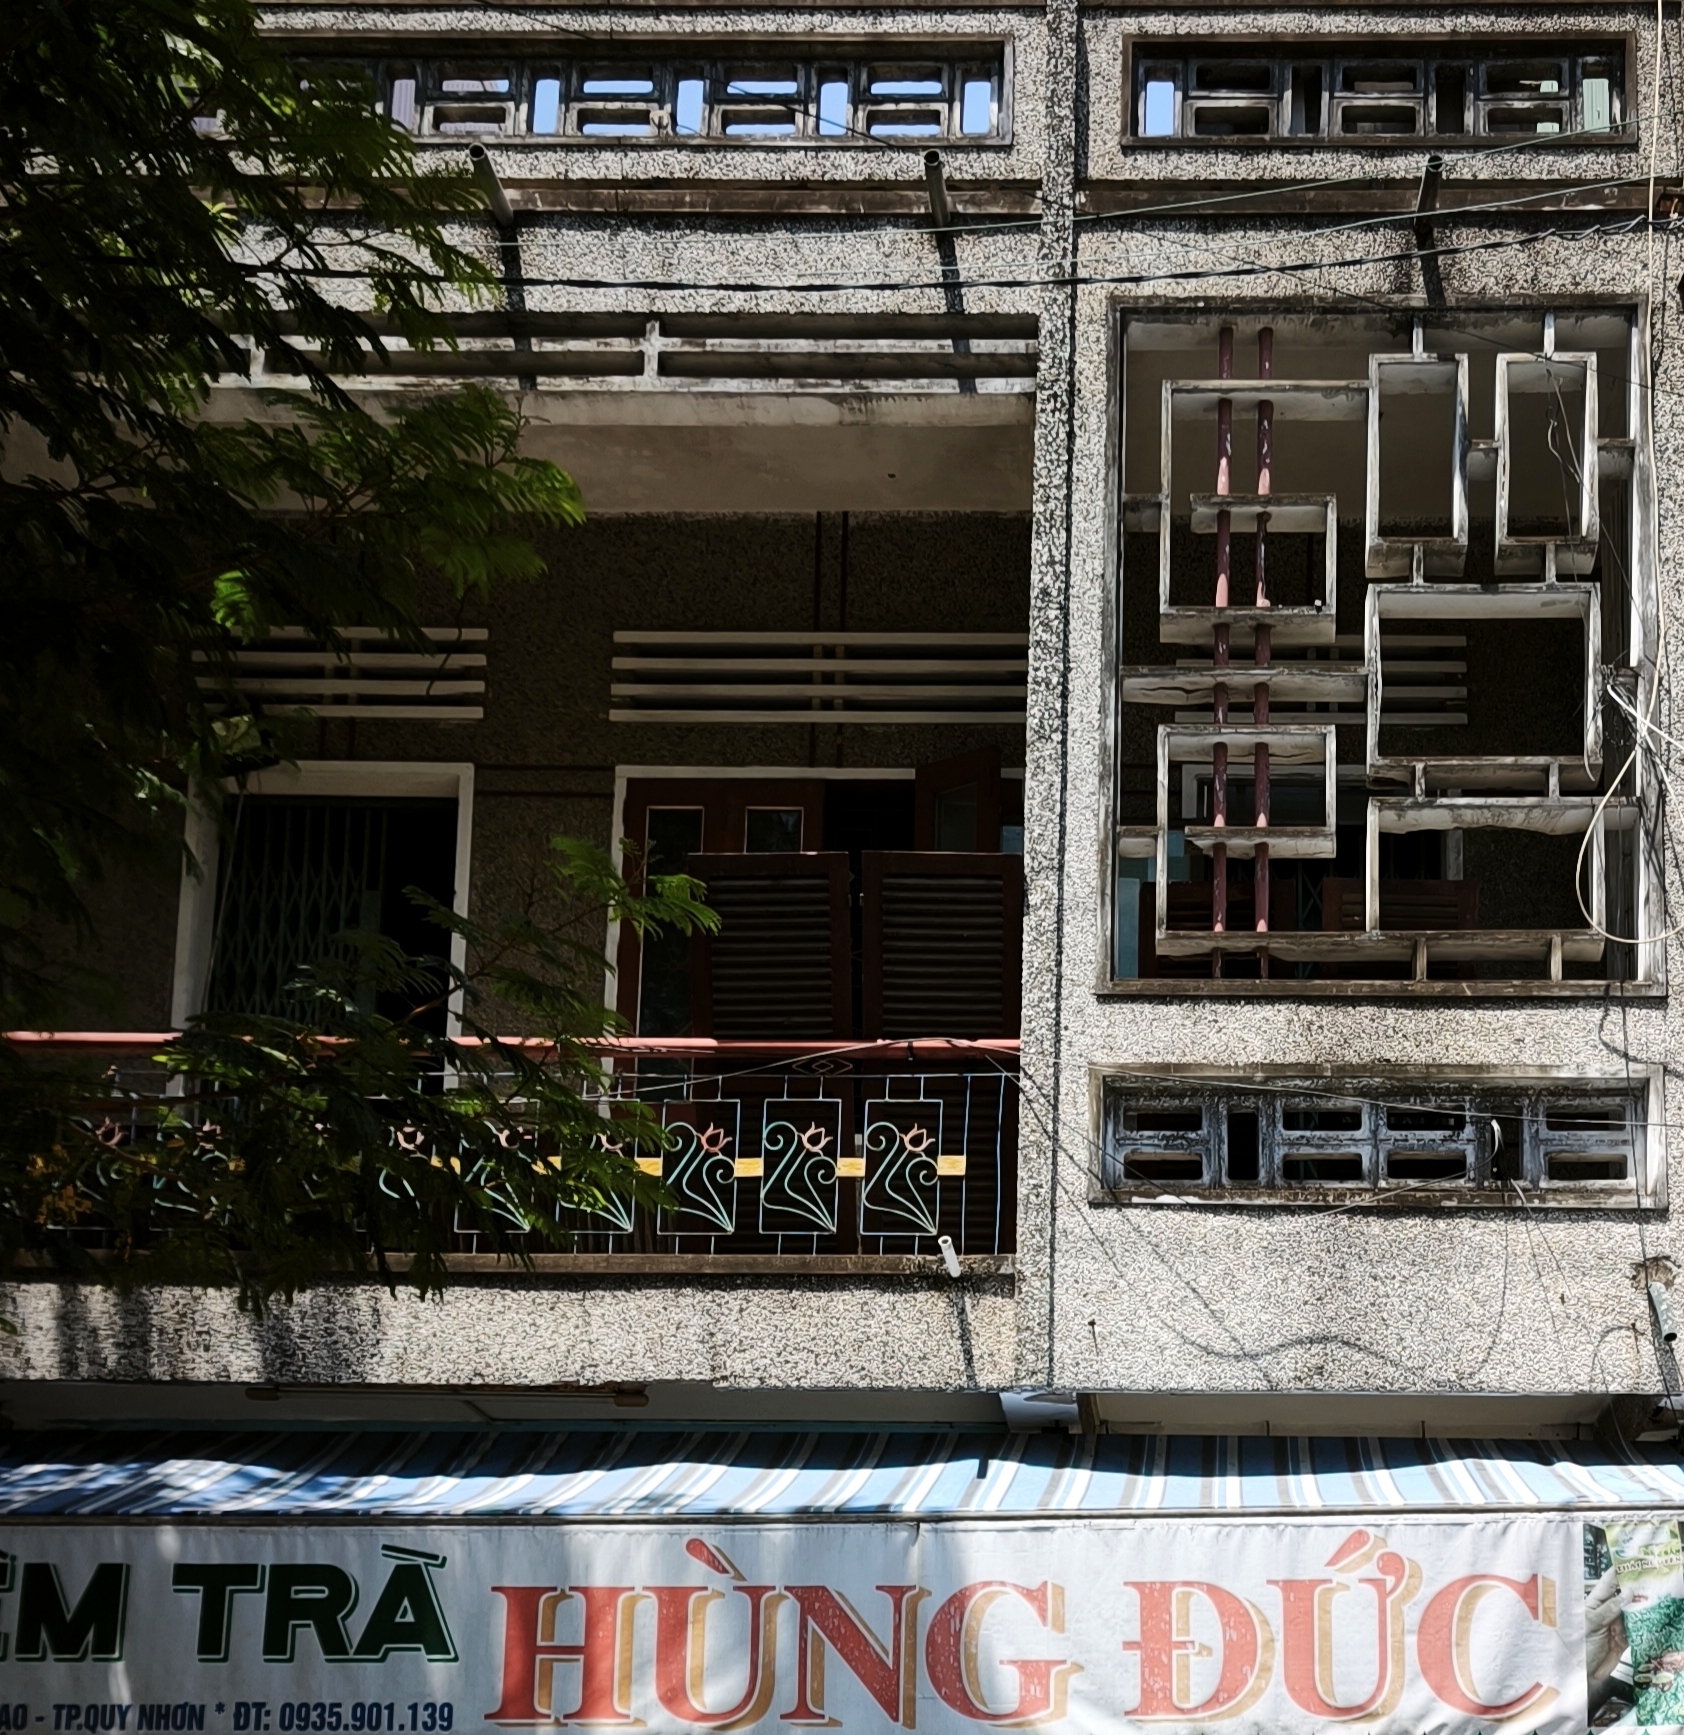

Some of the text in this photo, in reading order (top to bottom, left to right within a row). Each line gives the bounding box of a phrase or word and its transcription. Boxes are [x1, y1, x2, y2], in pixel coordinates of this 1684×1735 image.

[0, 1544, 459, 1663] M TRÀ
[484, 1529, 1561, 1730] HÙNG ĐỨC
[53, 1704, 132, 1733] TP.QUY
[137, 1702, 205, 1731] NHƠN
[233, 1702, 271, 1731] ĐT:
[279, 1702, 454, 1732] 0935.901.139
